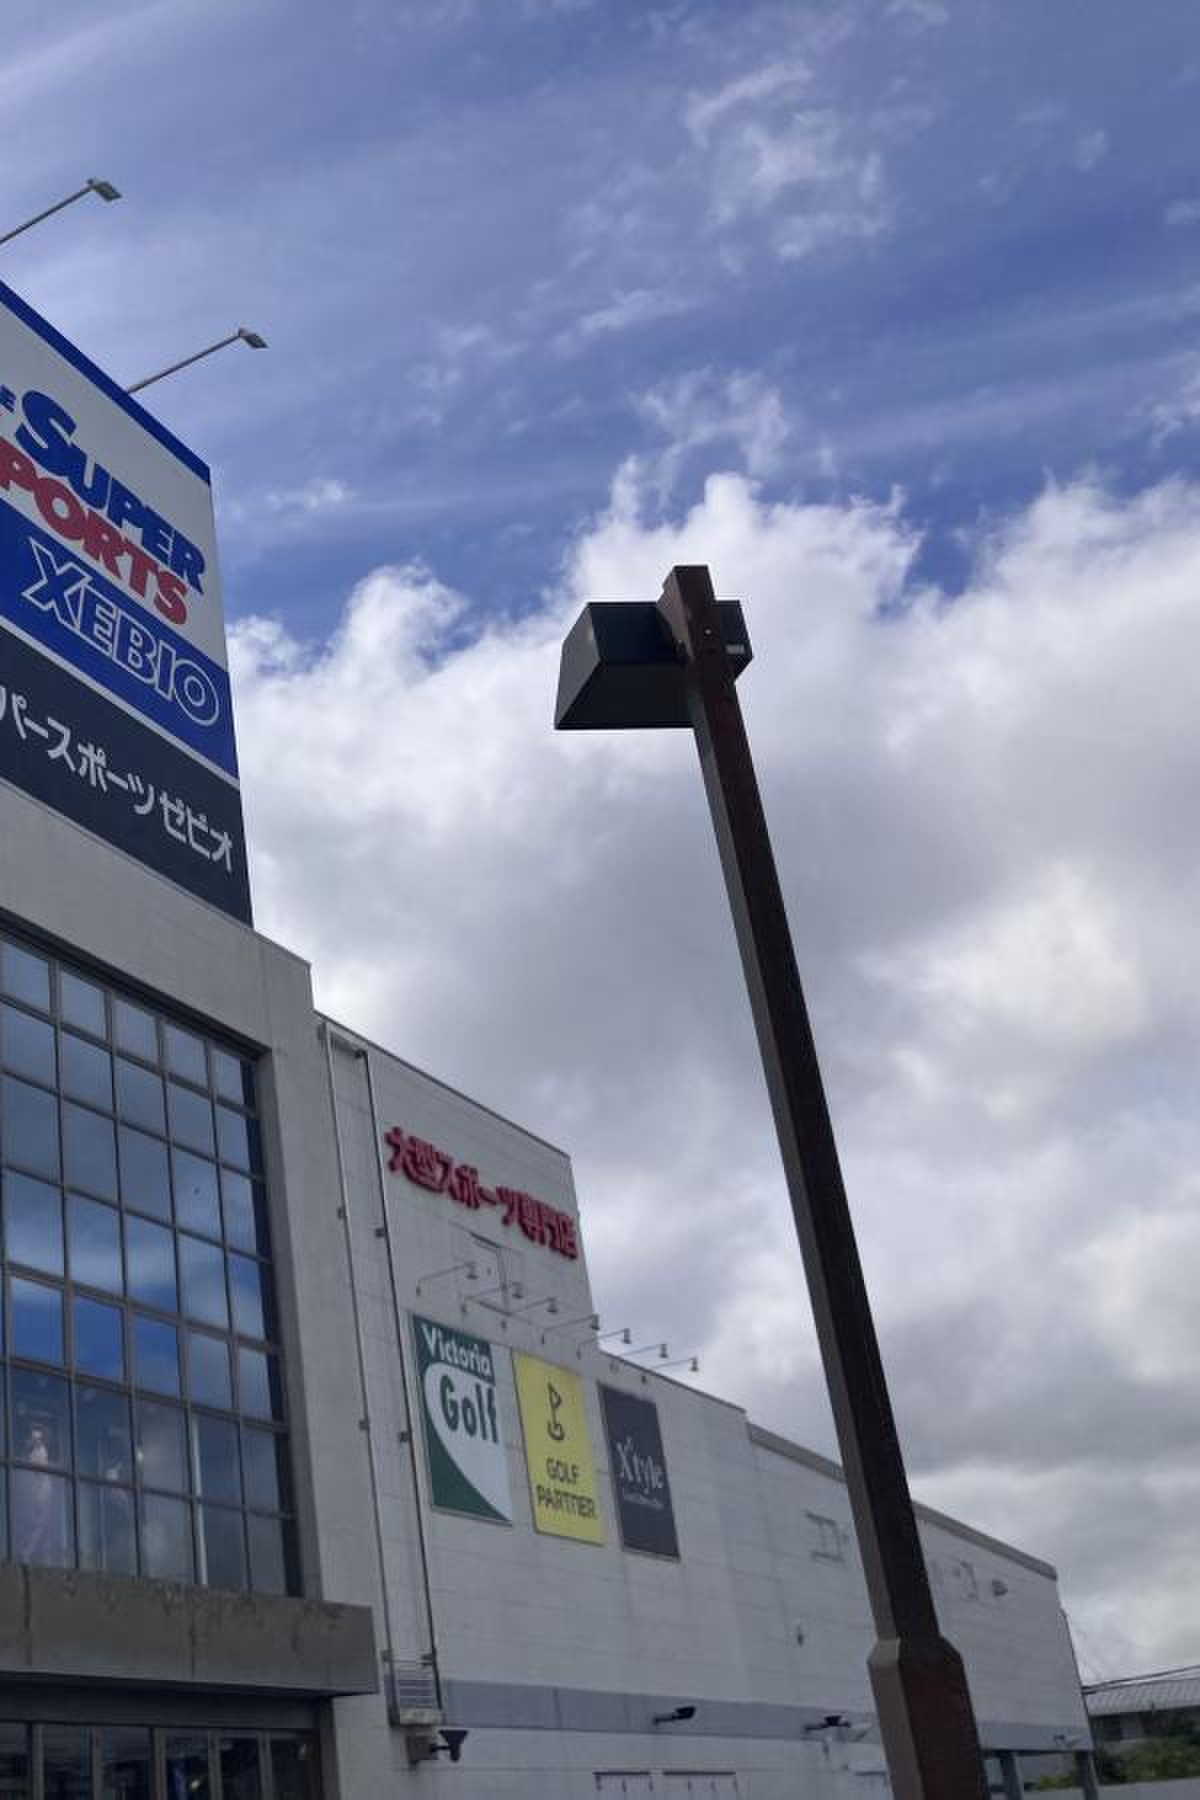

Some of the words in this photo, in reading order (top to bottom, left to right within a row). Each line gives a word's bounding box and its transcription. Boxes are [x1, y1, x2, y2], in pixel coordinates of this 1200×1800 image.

[16, 390, 205, 594] SUPER
[21, 536, 220, 727] XEBIO
[422, 1323, 492, 1376] Victoria
[439, 1373, 499, 1444] Golf
[545, 1457, 579, 1484] GOLF
[537, 1486, 596, 1519] PARTNER
